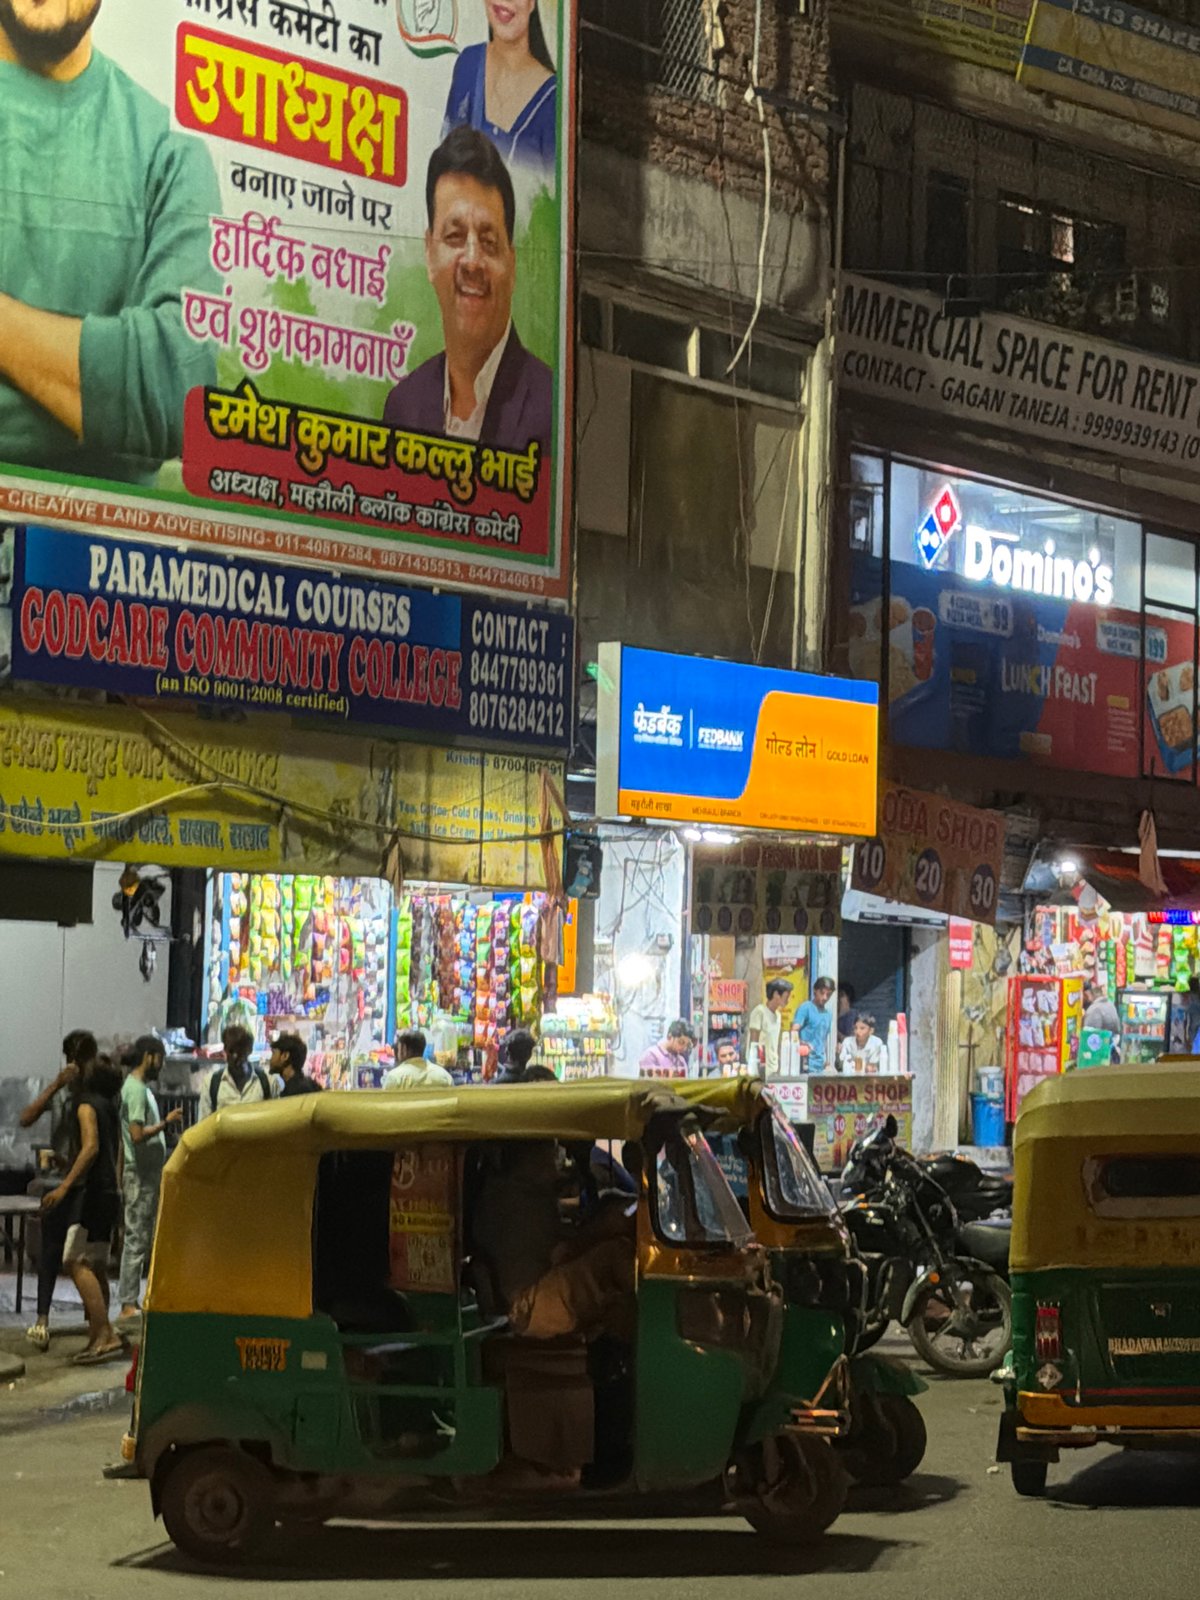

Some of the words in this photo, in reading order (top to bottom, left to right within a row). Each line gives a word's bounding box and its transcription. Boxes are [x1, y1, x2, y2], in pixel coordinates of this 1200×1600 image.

[348, 24, 382, 65] का
[184, 34, 401, 177] उपाध्यक्ष
[302, 179, 355, 221] जाने
[362, 197, 393, 230] पर
[211, 211, 306, 279] हार्दिक
[185, 290, 232, 345] एवं
[992, 327, 1074, 391] SPACE
[1076, 350, 1128, 405] FOR
[1130, 364, 1197, 420] RENT
[843, 350, 926, 393] CONTACT
[940, 376, 1005, 413] GAGAN
[1008, 391, 1069, 431] TANEJA
[1083, 411, 1178, 454] 9999939143
[207, 384, 291, 449] रमेश
[298, 410, 392, 472] कुमार
[480, 441, 539, 499] भाई
[8, 491, 97, 518] CREATIVE
[102, 504, 150, 527] LAND
[290, 481, 355, 515] महरौली
[360, 489, 411, 524] ब्लॉक
[415, 500, 470, 535] कांग्रेस
[474, 509, 522, 544] कमेटी
[964, 524, 1114, 605] Domino's
[89, 545, 290, 619] PARAMEDICAL
[296, 584, 411, 637] COURSES
[21, 586, 169, 672] GODCARE
[174, 612, 342, 695] COMMUNITY
[349, 638, 462, 708] COLLEGE
[471, 610, 549, 655] CONTACT
[183, 675, 210, 696] ISO
[286, 692, 350, 719] certified)
[470, 651, 565, 698] 8447799361
[1001, 657, 1051, 698] LUNCH
[469, 694, 565, 737] 8076284212
[698, 727, 744, 746] FEDBANK
[766, 732, 792, 757] गोल्ड
[795, 735, 816, 759] लोन
[826, 750, 847, 762] GOLD
[848, 752, 869, 764] LOAN
[936, 807, 997, 855] SHOP
[860, 842, 884, 879] 10
[916, 857, 941, 895] 20
[971, 874, 995, 909] 30
[813, 1083, 858, 1102] SODA
[864, 1082, 909, 1102] SHOP
